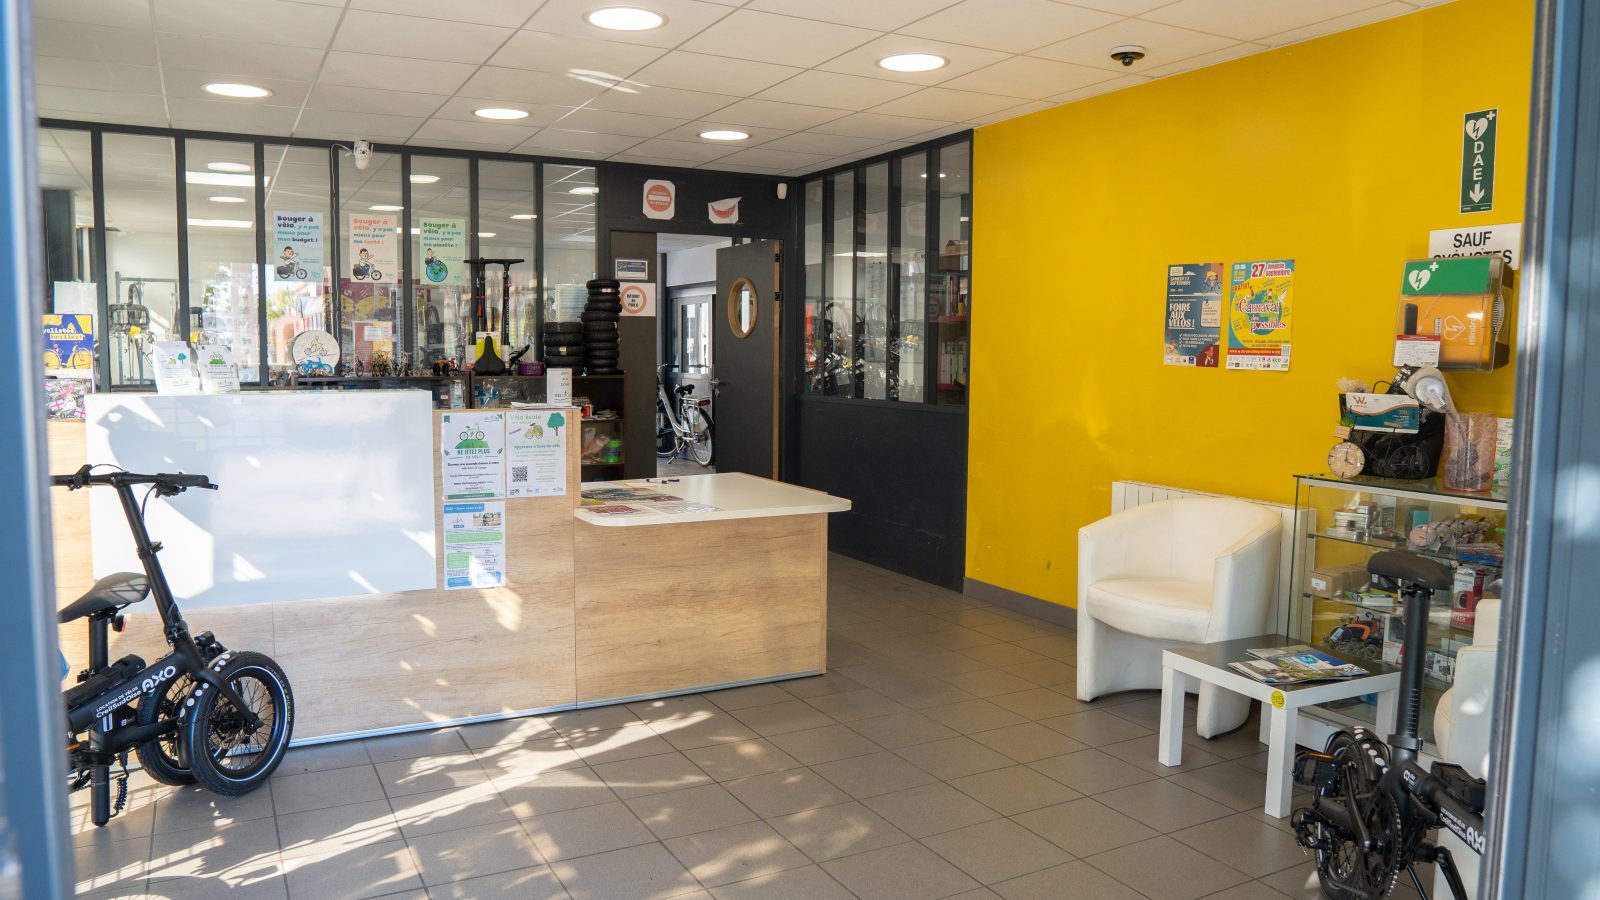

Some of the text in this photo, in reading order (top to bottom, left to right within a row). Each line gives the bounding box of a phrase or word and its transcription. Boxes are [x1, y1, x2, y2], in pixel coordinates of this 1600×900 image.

[1473, 141, 1484, 181] DAE
[1453, 231, 1493, 248] SAUF
[1252, 264, 1265, 278] 27
[1232, 282, 1250, 292] GRATUIT
[1169, 303, 1190, 312] FOIRE
[1240, 298, 1279, 312] Carnaval
[142, 666, 176, 693] AXO
[96, 698, 118, 712] LOCATION
